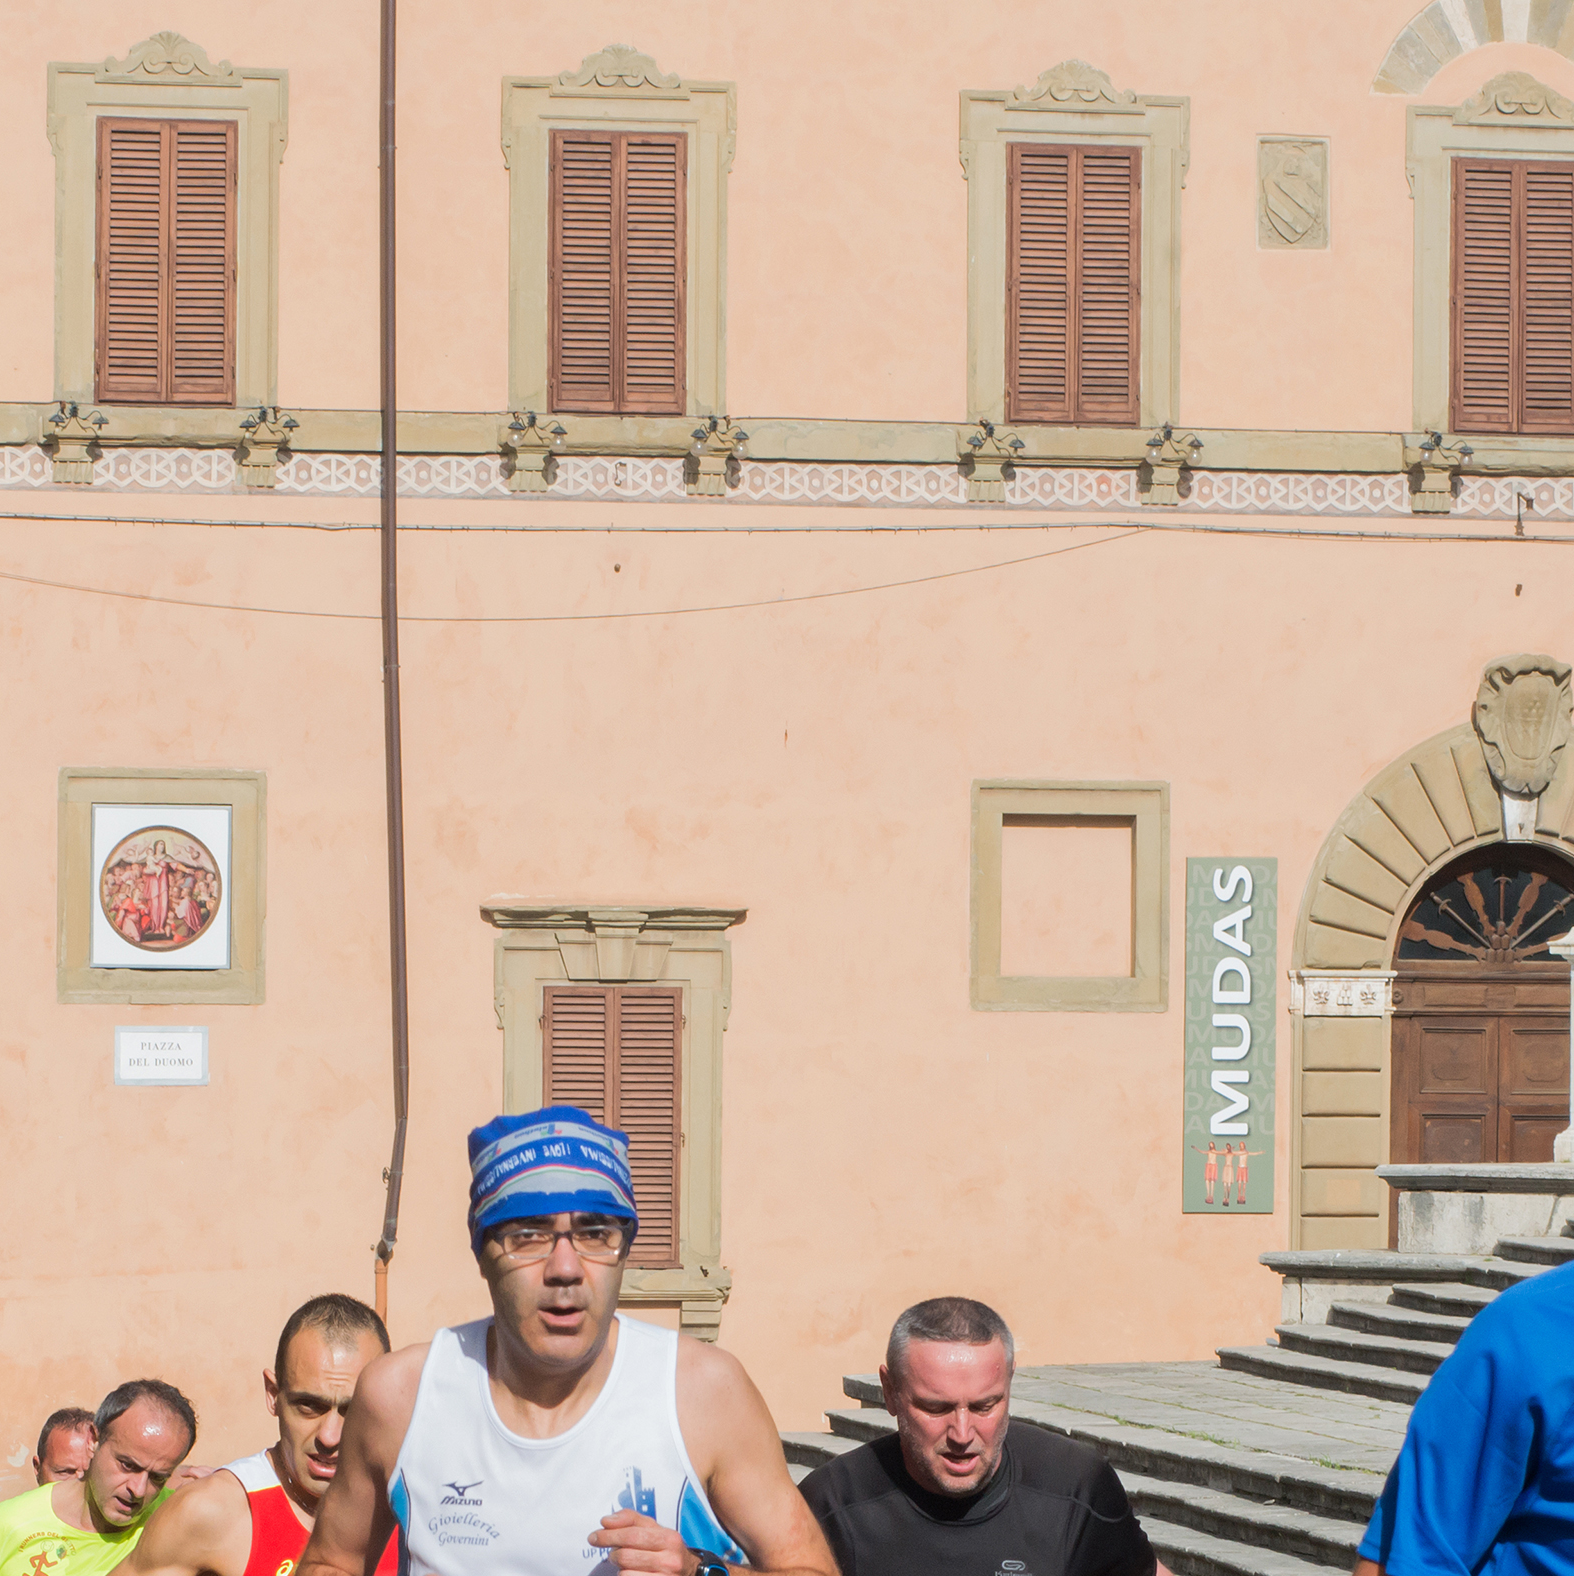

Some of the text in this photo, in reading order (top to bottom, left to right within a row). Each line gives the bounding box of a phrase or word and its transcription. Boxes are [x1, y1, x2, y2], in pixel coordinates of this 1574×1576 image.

[1210, 865, 1253, 1136] MUDAS
[140, 1041, 182, 1051] PIAZZA
[128, 1058, 194, 1067] DEL DUOMO
[543, 1142, 566, 1157] LOVE
[427, 1512, 501, 1540] Gioielleria
[437, 1531, 490, 1547] Governini
